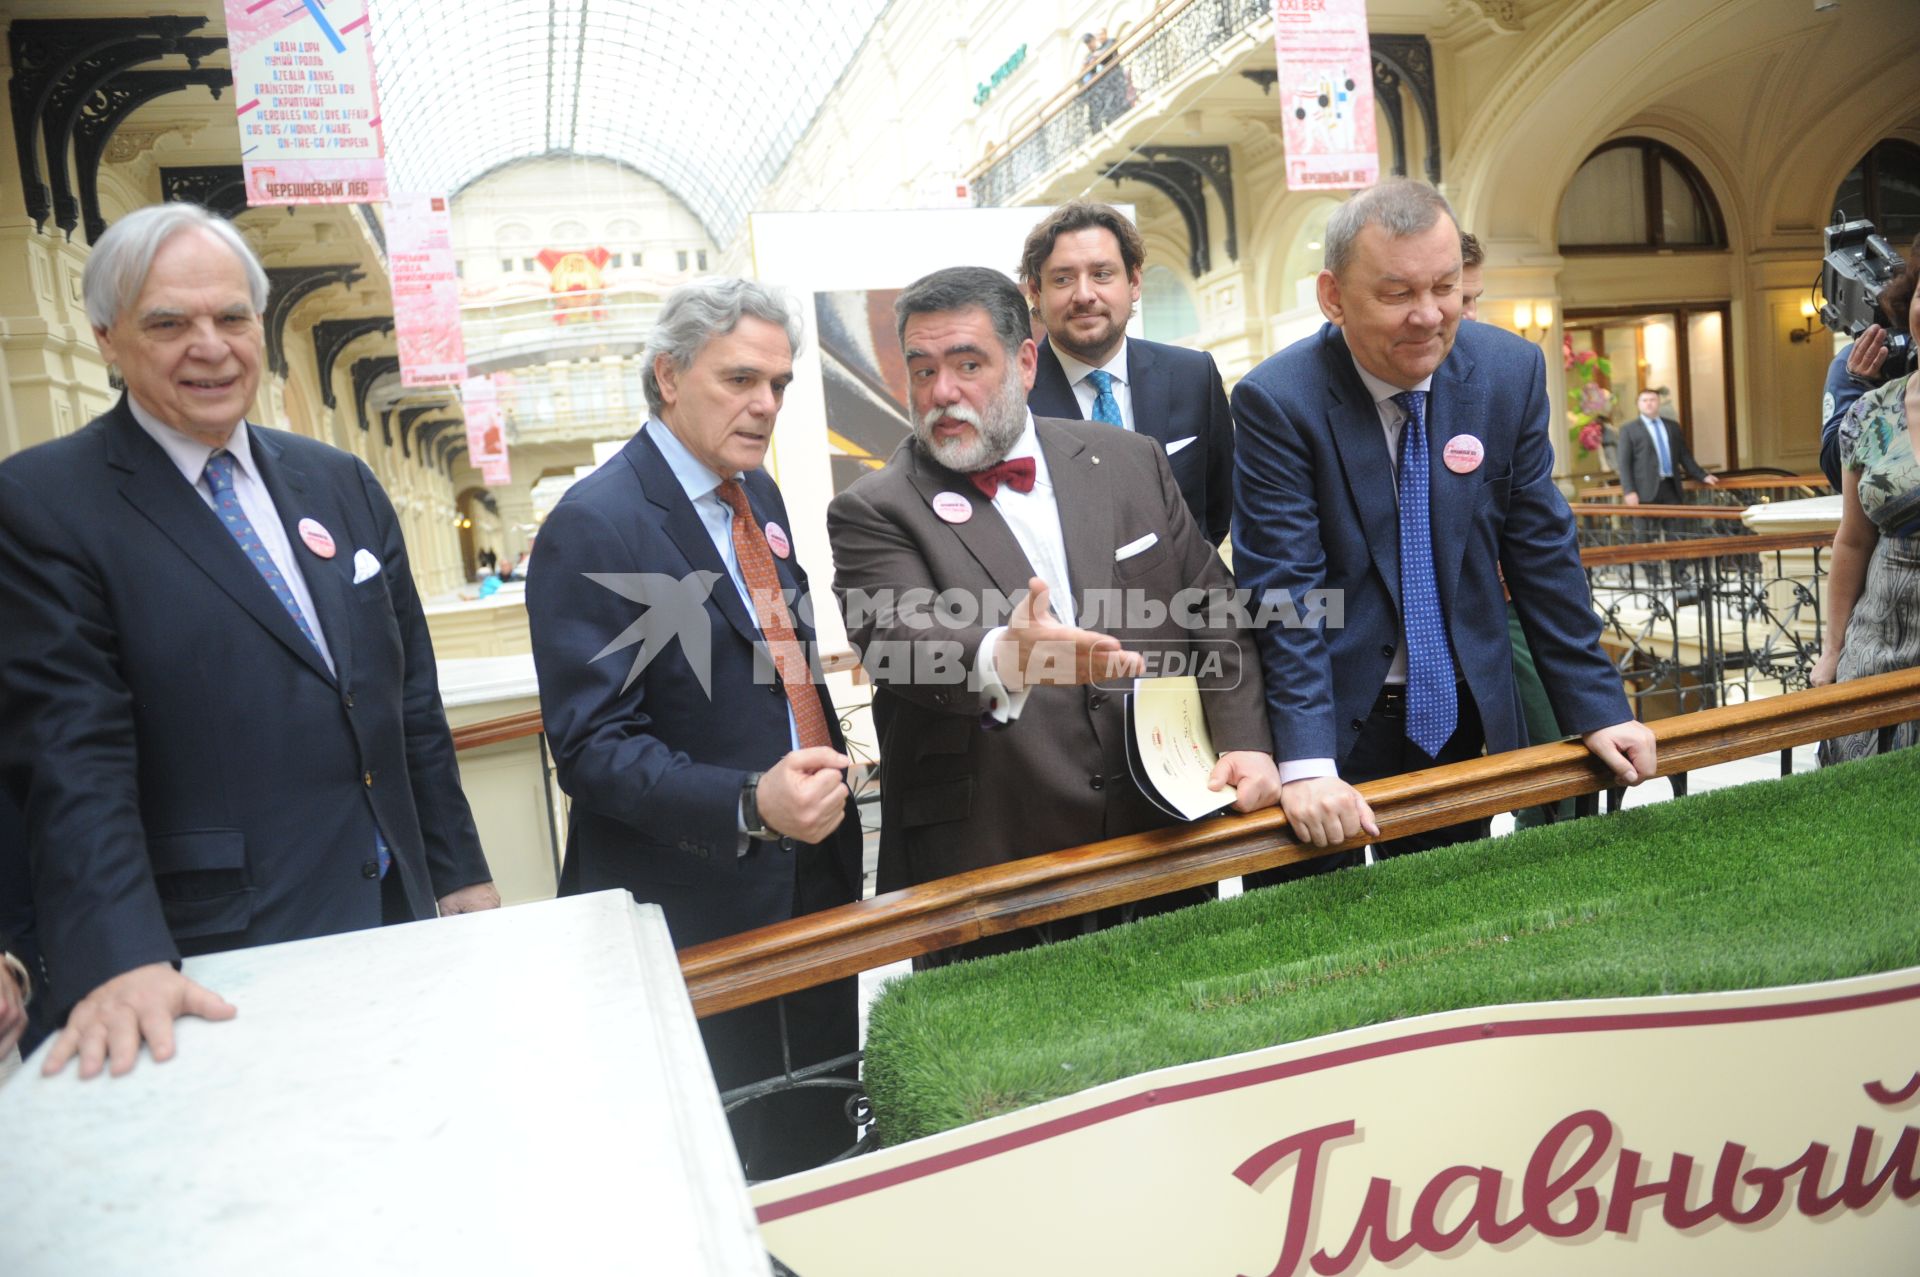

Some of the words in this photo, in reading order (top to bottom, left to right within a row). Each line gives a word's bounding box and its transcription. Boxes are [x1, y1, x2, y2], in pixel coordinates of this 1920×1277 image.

[274, 41, 297, 53] ИВАН
[299, 41, 320, 53] ДОРН
[265, 53, 293, 66] МУМИЙ
[294, 55, 324, 66] ТРОЛЛЬ
[308, 70, 334, 81] BANKS
[254, 83, 304, 95] BRAINSTORM
[314, 83, 337, 95] TESLA
[339, 83, 355, 95] BOY
[272, 96, 324, 108] СКРИПТОНИТ
[257, 109, 301, 121] HERCULES
[303, 109, 319, 121] AND
[320, 109, 340, 120] LOVE
[266, 182, 344, 198] ЧЕРЕШНЕВЫЙ
[347, 181, 369, 196] ЛЕС
[1232, 1070, 1920, 1277] Главный
